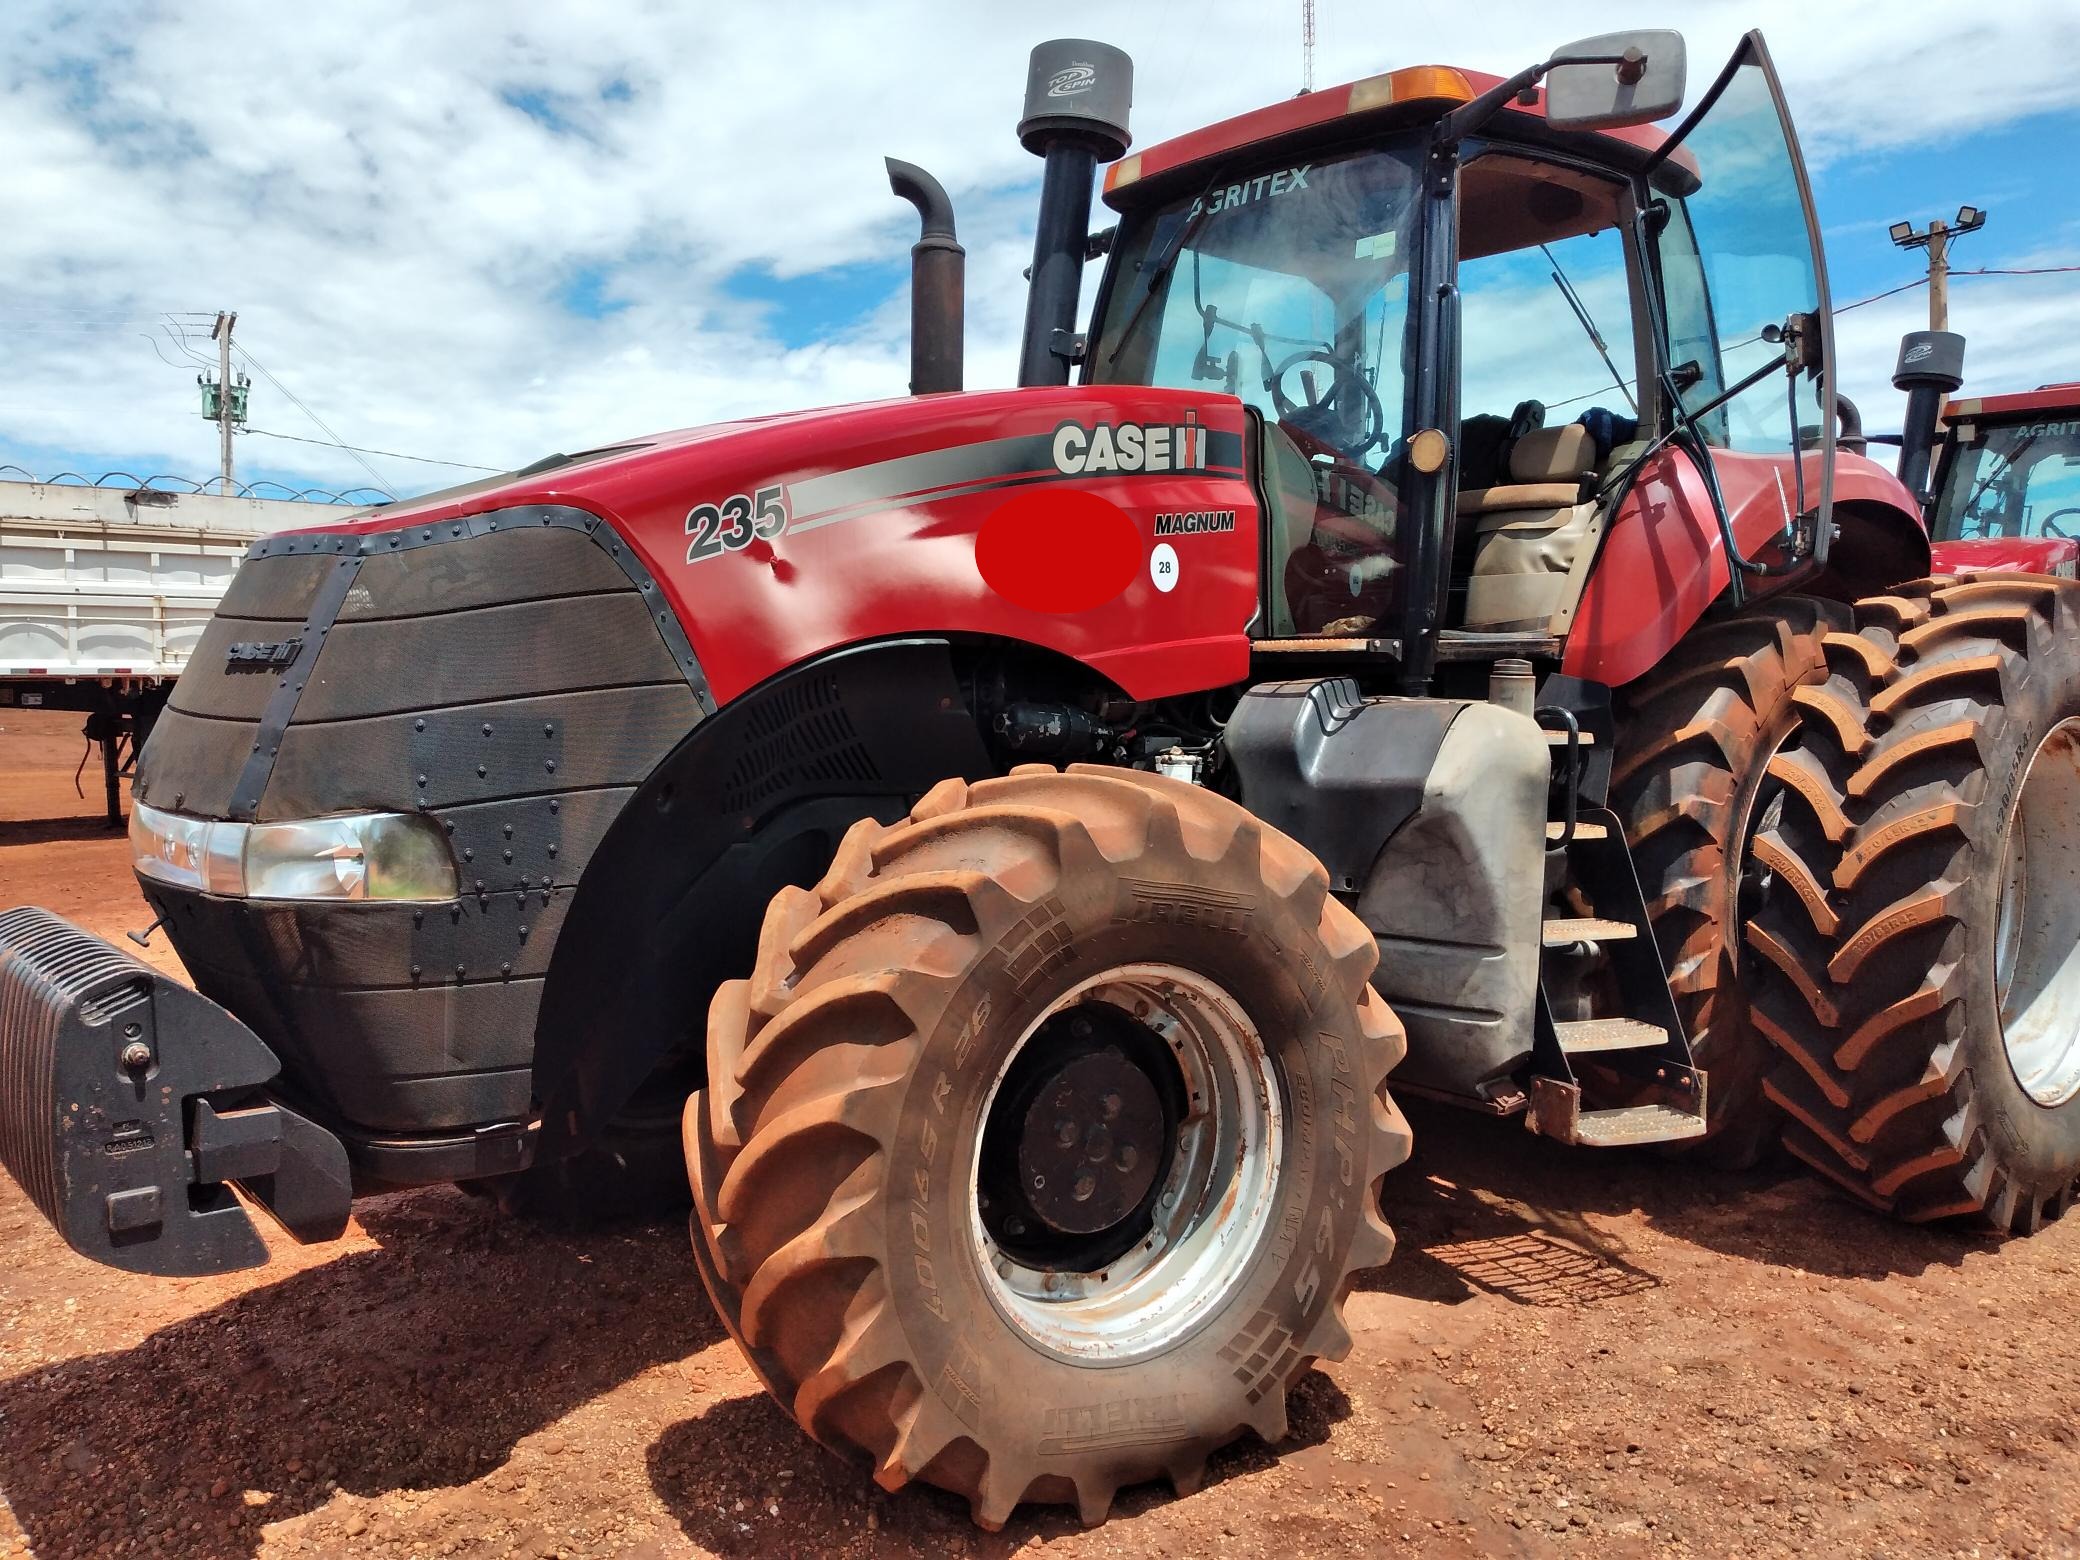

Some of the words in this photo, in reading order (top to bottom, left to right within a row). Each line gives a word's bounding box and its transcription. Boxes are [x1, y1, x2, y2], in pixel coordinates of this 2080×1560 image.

[1048, 72, 1078, 88] TOP
[1063, 78, 1096, 89] SPIN
[1053, 424, 1170, 474] CASE
[685, 483, 787, 565] 235
[1154, 510, 1235, 536] MAGNUM
[1158, 561, 1171, 574] 28
[931, 1069, 953, 1116] R
